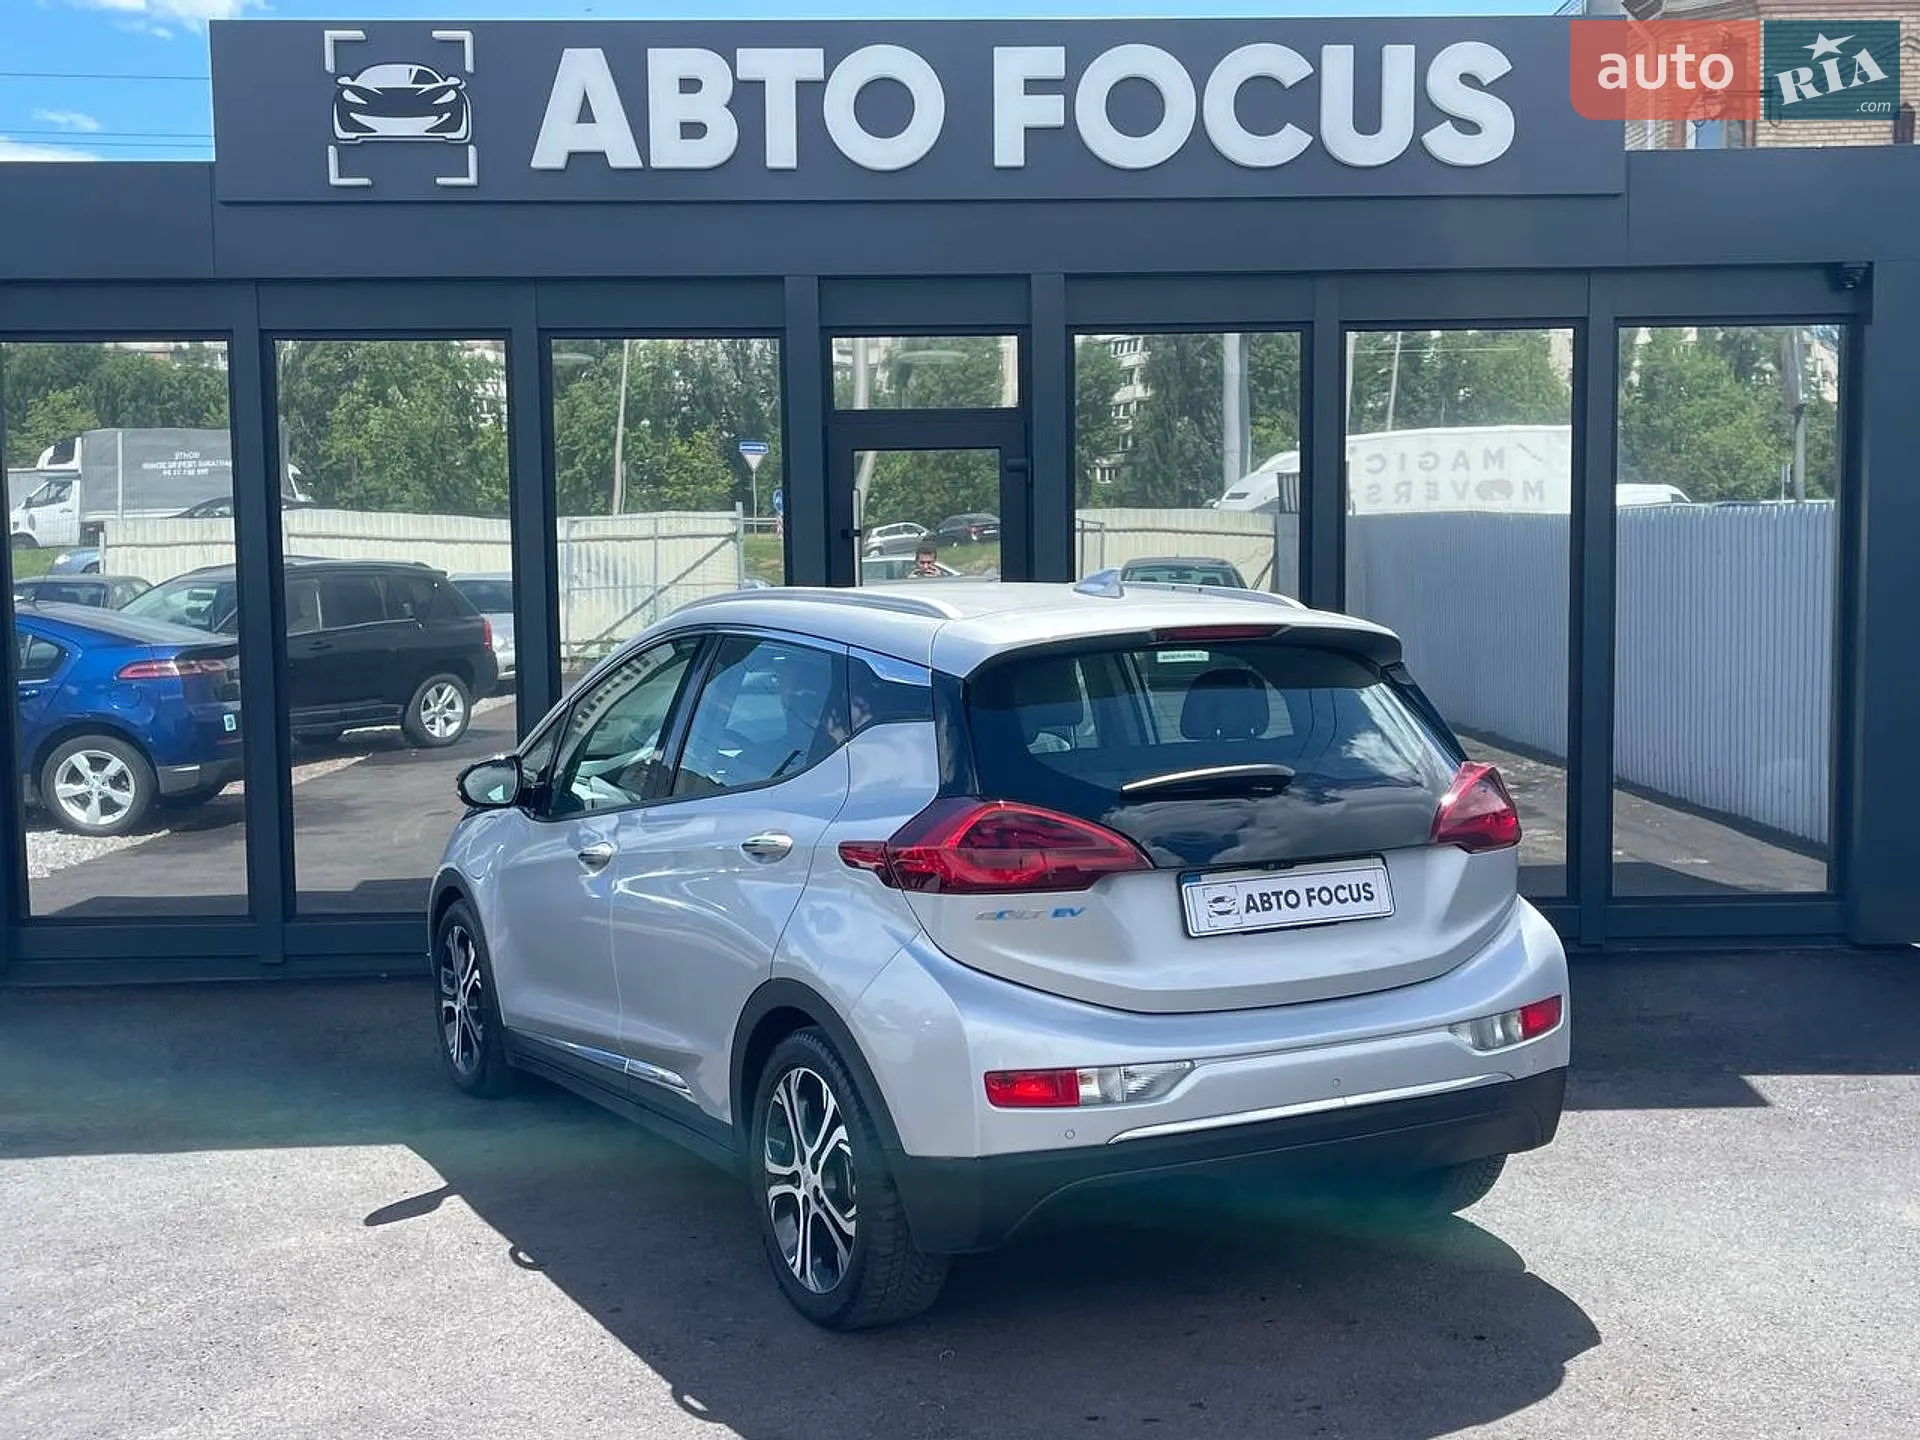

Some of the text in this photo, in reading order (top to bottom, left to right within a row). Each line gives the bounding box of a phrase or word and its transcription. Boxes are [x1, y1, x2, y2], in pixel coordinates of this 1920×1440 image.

[530, 41, 1516, 171] АВТО FOCUS
[1244, 882, 1375, 914] АВТО FOCUS
